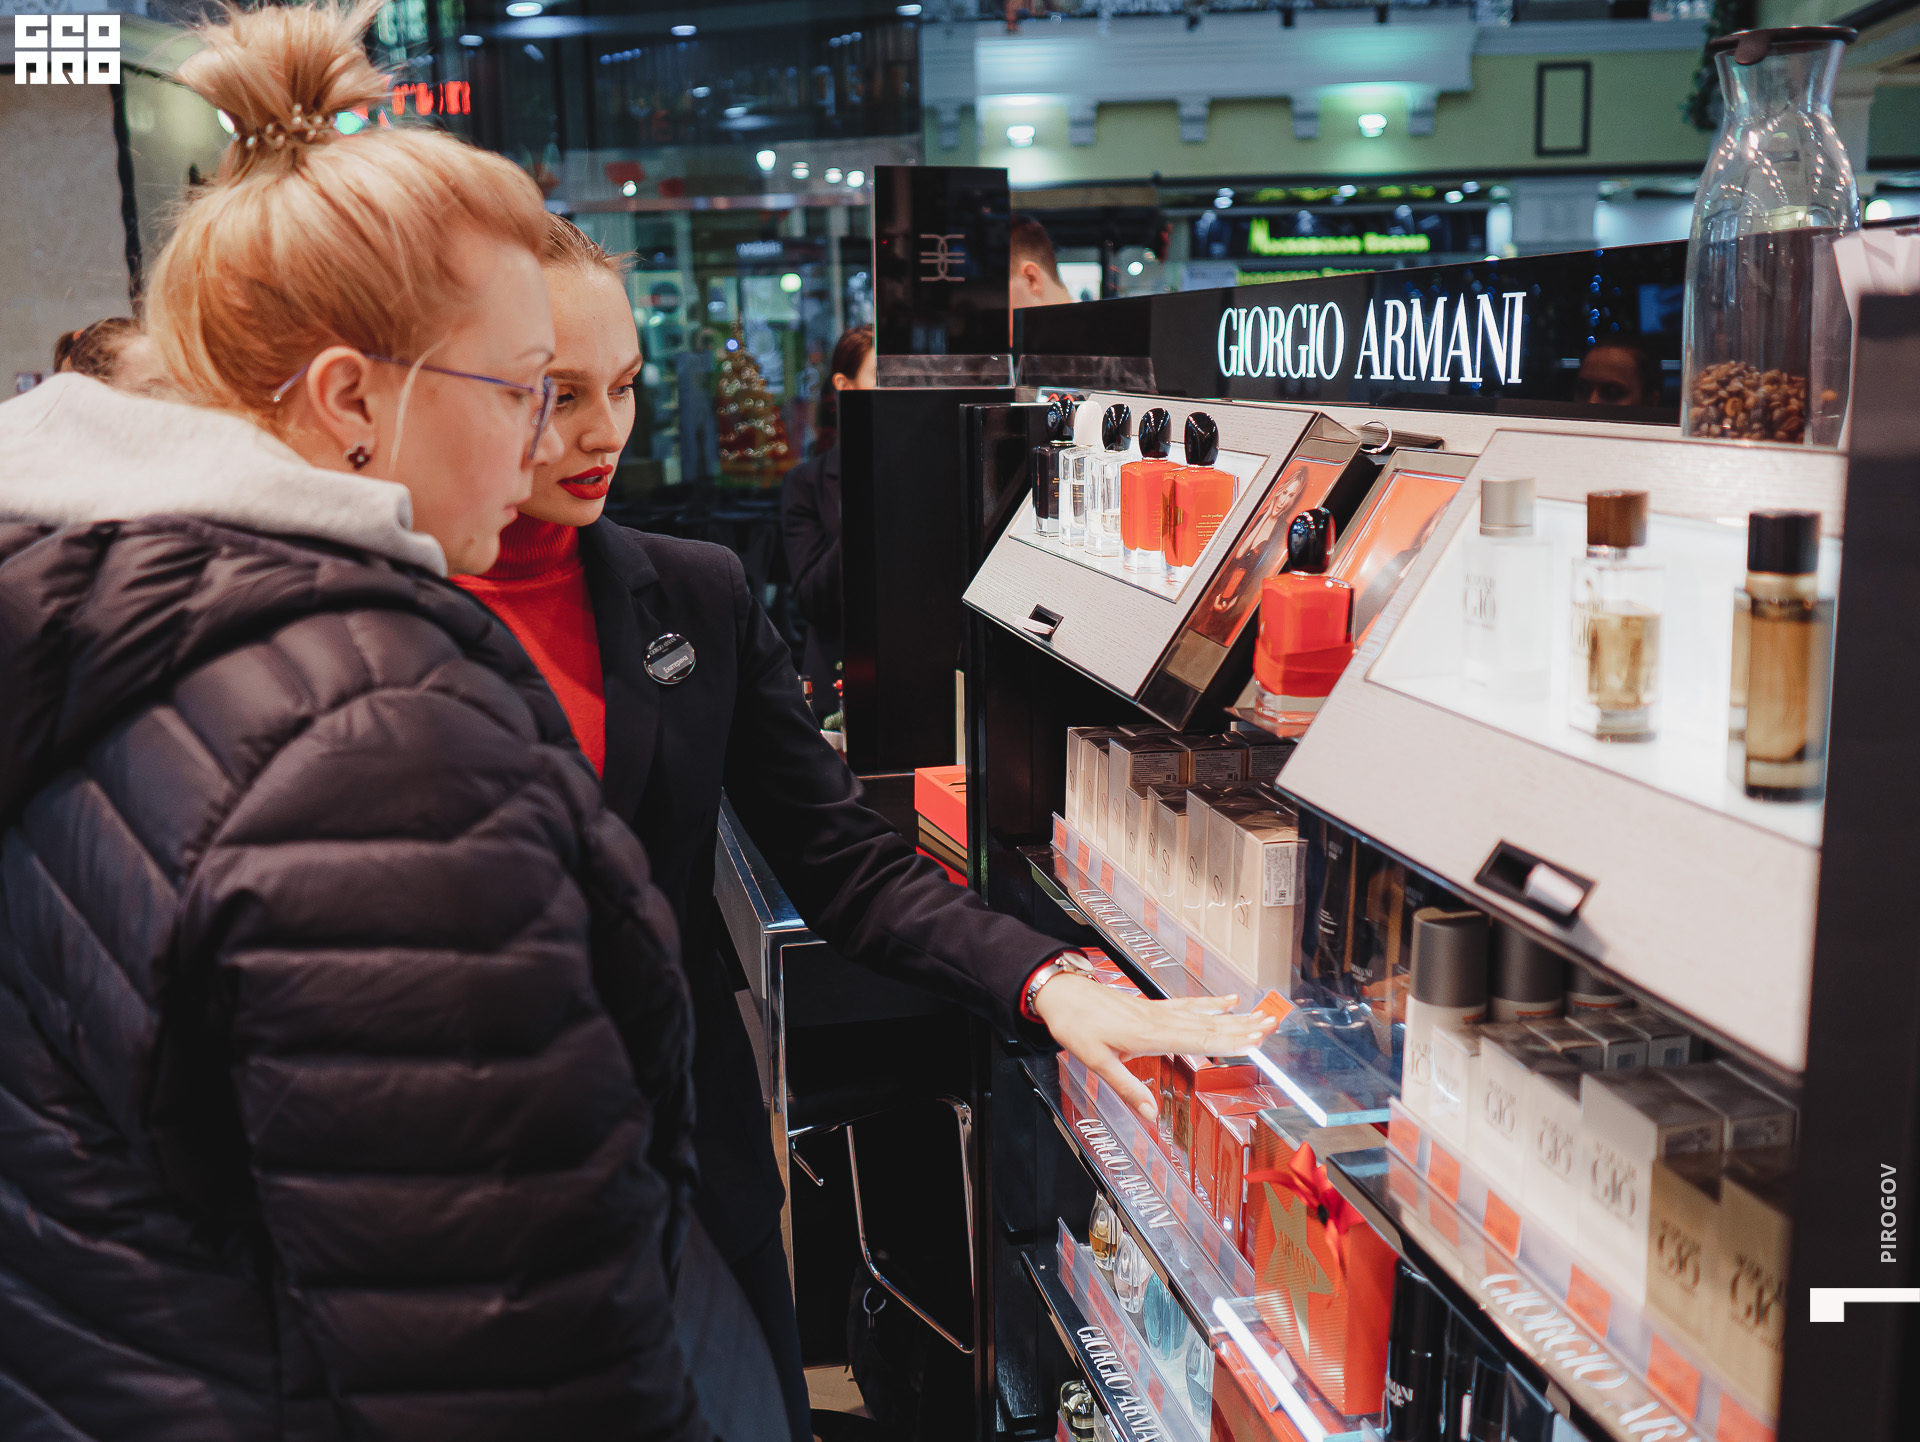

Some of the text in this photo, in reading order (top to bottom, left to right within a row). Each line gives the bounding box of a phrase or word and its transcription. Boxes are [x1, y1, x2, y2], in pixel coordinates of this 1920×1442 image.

[1218, 292, 1527, 385] GIORGIO ARMANI
[1076, 889, 1132, 927] GIORGIO
[1076, 1118, 1179, 1229] GIORGIO ARMANI
[1076, 1325, 1133, 1390] GIORGIO
[1480, 1273, 1629, 1389] GIORGIO
